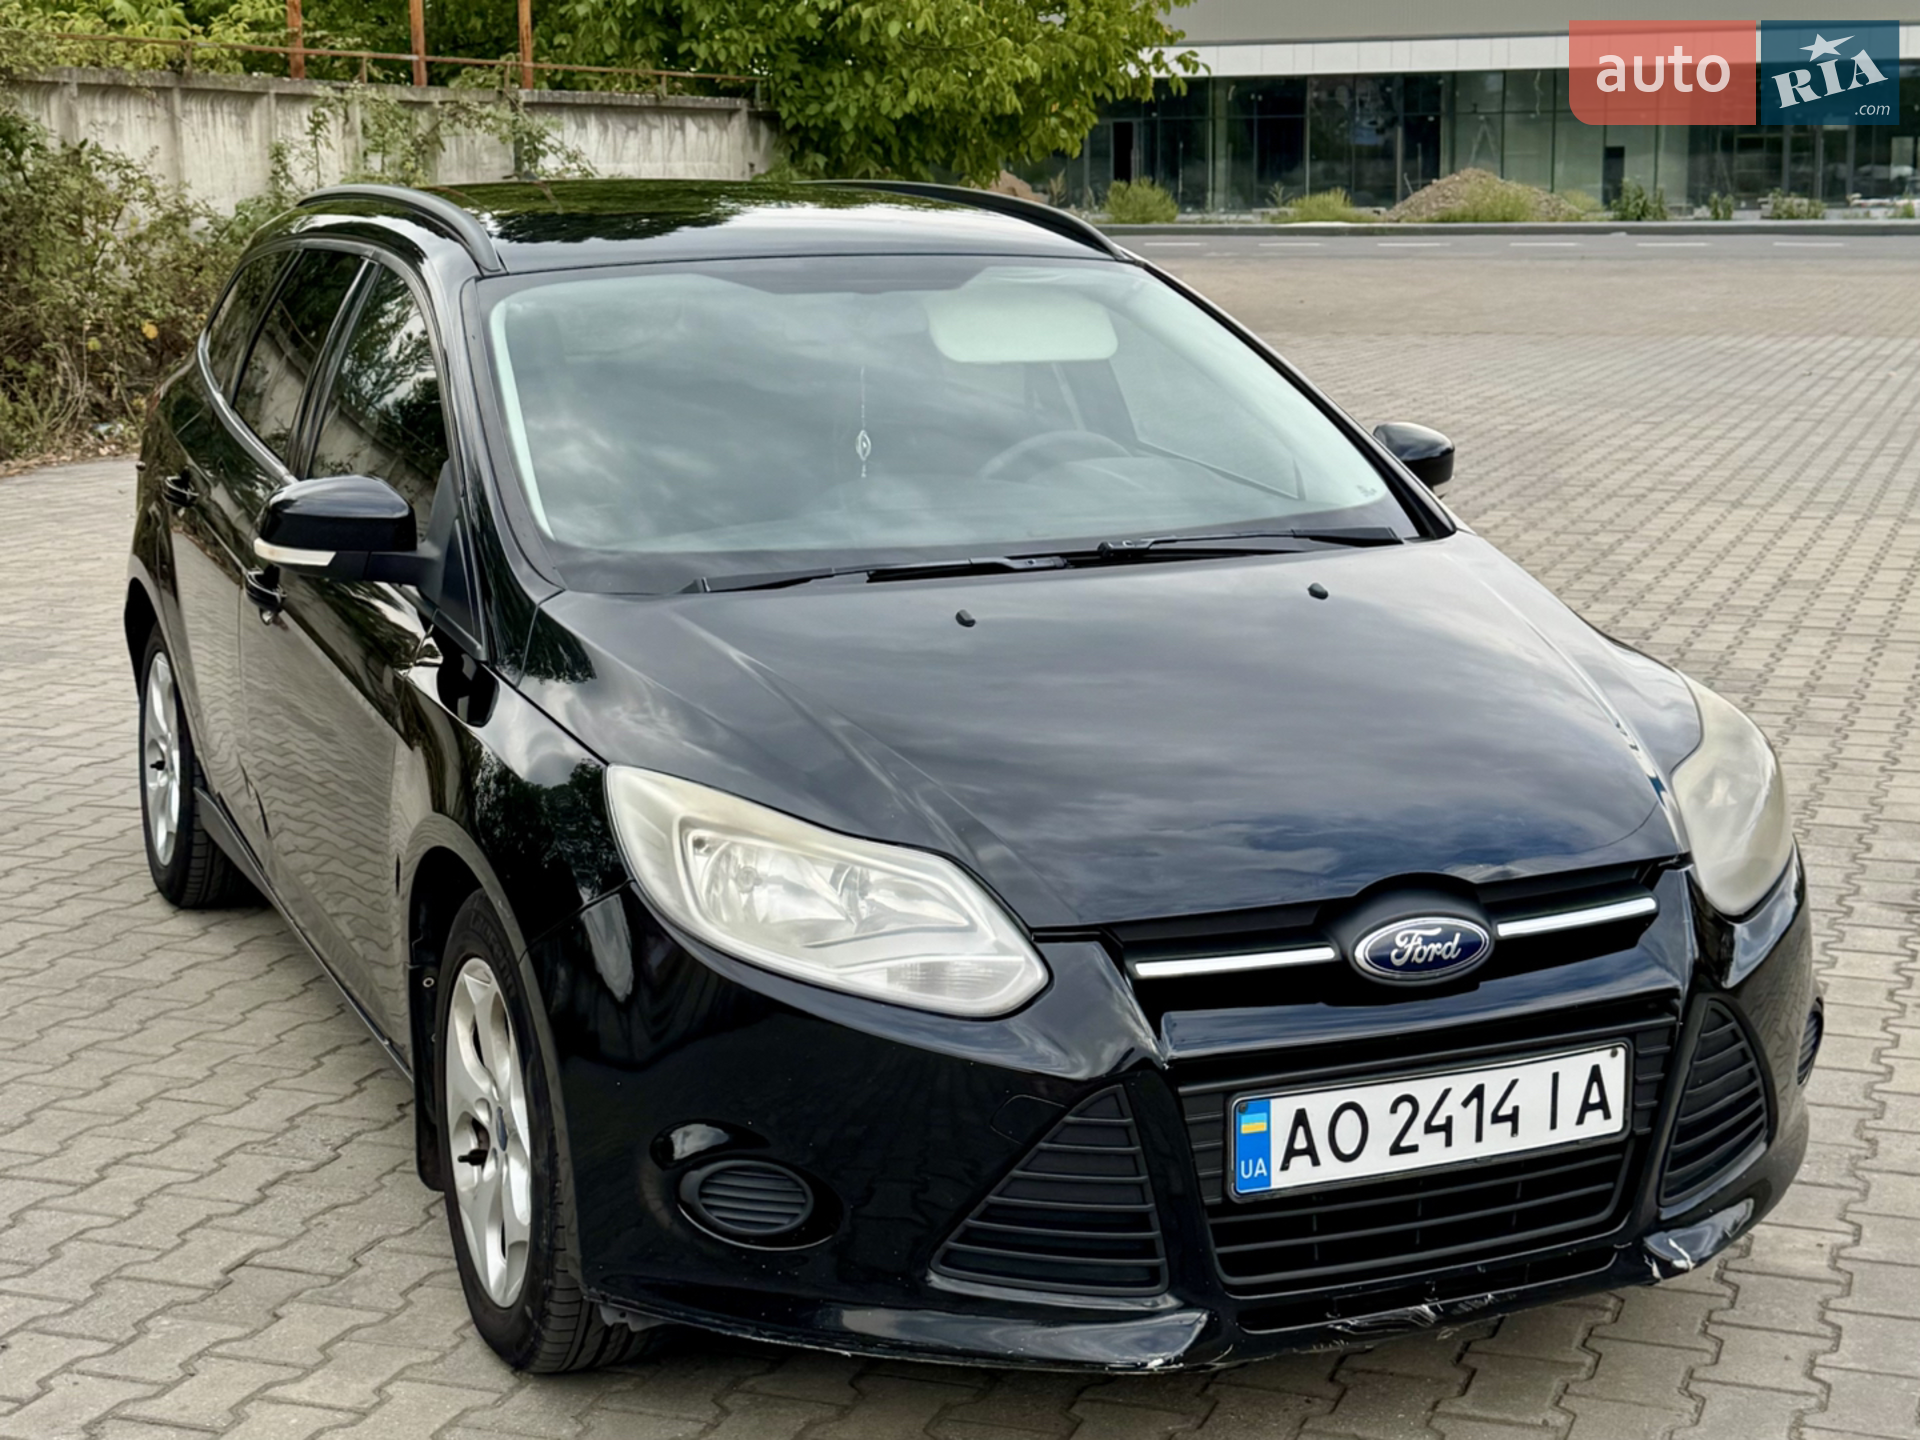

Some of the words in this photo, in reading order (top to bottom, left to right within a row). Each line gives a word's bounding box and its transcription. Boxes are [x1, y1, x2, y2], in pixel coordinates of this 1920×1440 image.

[1390, 927, 1462, 966] Ford
[1279, 1101, 1370, 1172] AO
[1388, 1077, 1520, 1157] 2414
[1548, 1063, 1613, 1131] IA
[1240, 1158, 1268, 1180] UA
